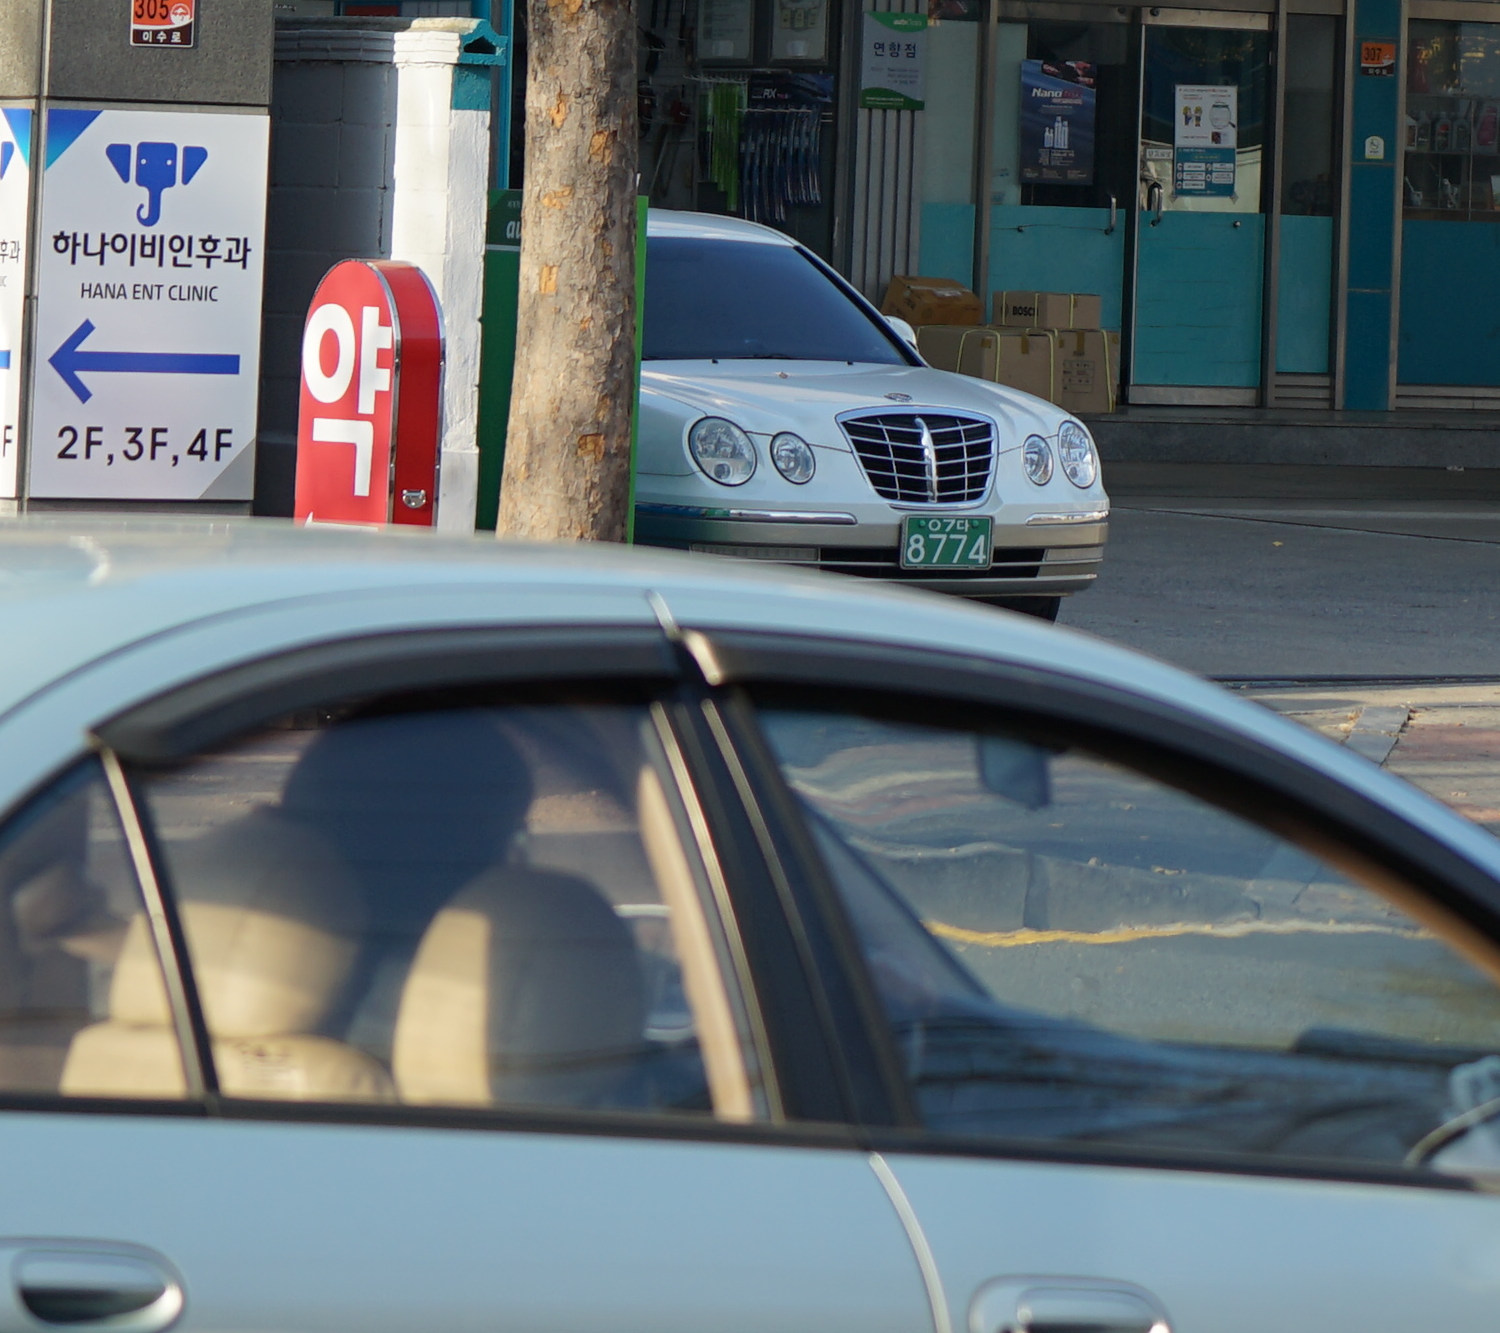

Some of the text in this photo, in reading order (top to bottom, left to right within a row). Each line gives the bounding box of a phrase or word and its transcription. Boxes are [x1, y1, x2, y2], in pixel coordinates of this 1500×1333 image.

[141, 30, 182, 44] 이수로
[873, 41, 917, 59] 연향점
[1364, 47, 1382, 62] 307
[52, 230, 252, 270] 하나이비인후과
[80, 282, 219, 303] HANA ENT CLINIC
[302, 301, 394, 498] 약
[906, 533, 987, 564] 8774
